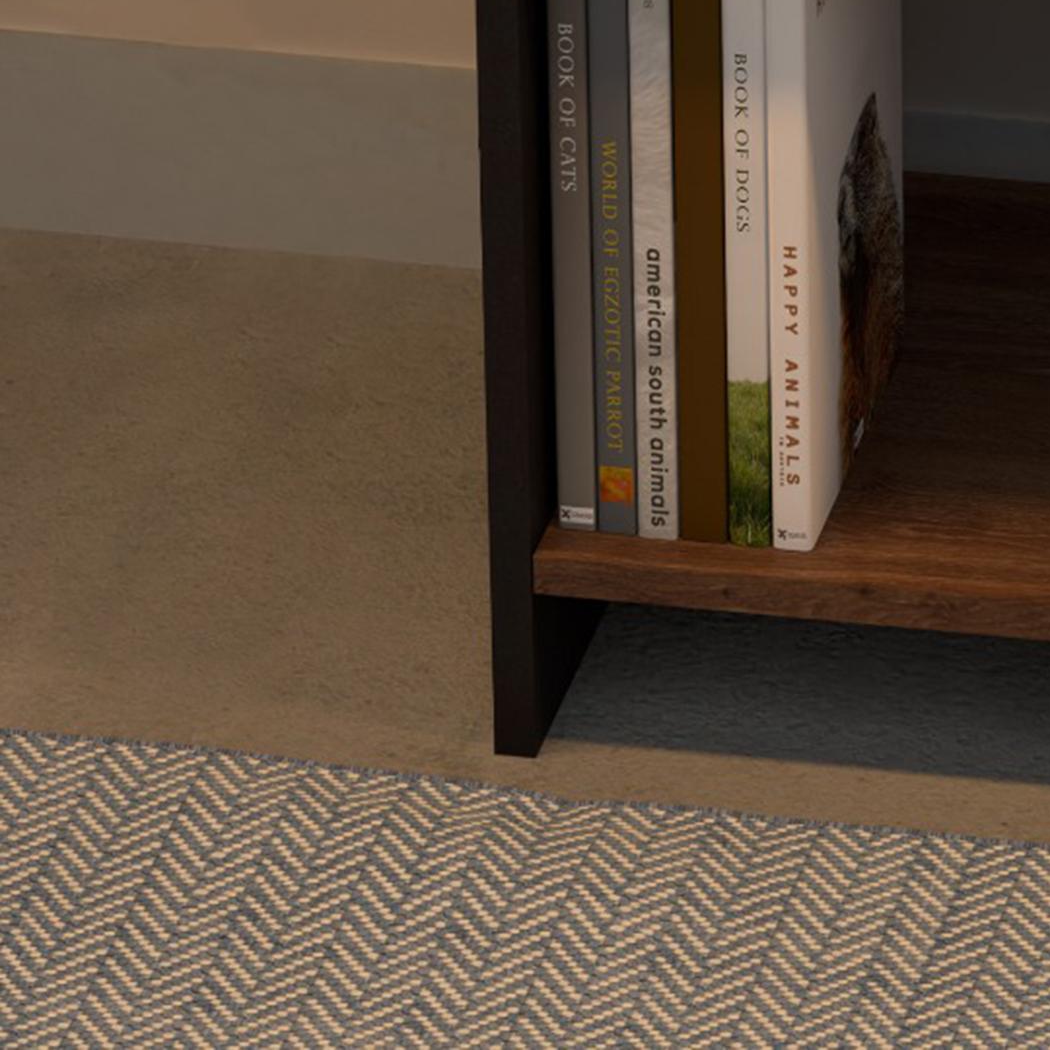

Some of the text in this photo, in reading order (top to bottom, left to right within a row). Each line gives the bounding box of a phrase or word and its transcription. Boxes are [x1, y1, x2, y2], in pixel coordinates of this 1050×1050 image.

[557, 23, 577, 192] BOOK OF CATS
[735, 54, 750, 233] BOOK OF DOGS
[601, 141, 624, 452] WORLD OF EGZOTIC PARROT
[647, 248, 670, 527] american south animals
[783, 245, 801, 485] HAPPY ANIMALS
